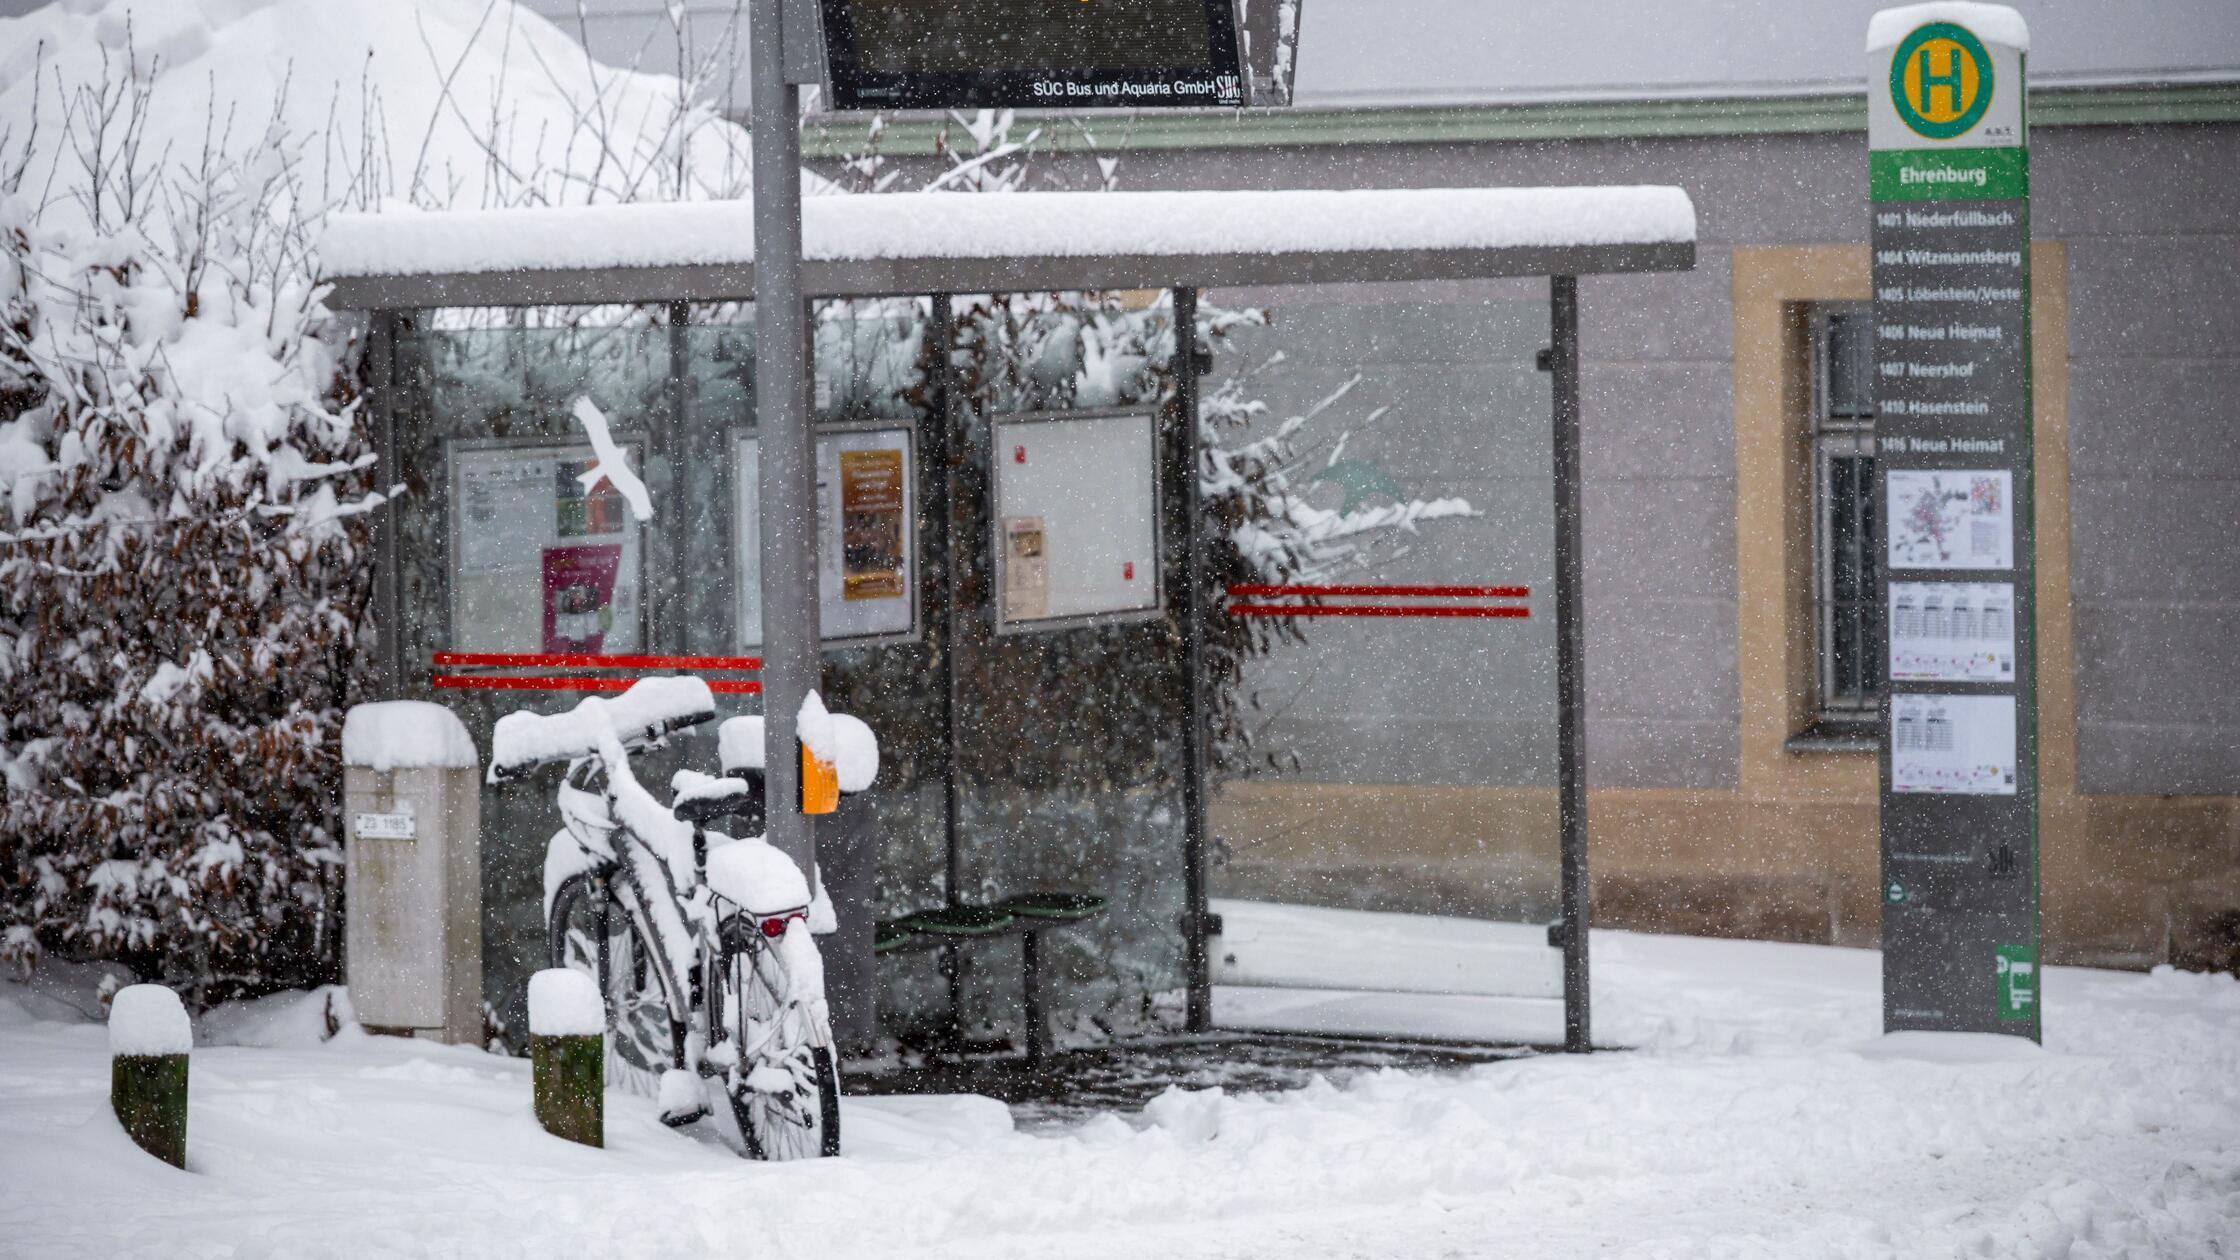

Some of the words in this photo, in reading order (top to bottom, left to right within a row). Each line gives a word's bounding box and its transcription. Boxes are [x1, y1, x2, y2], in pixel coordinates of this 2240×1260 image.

[1033, 80, 1063, 96] SÜC
[1066, 82, 1091, 96] Bus
[1095, 81, 1119, 95] und
[1121, 81, 1171, 97] Aquaria
[1173, 80, 1216, 95] GmbH
[1216, 71, 1241, 98] SÜC
[1919, 48, 1962, 113] H
[1900, 166, 1987, 186] Ehrenburg
[1876, 212, 1902, 228] 1401
[1906, 210, 2013, 227] Niederfüllbach
[1906, 250, 2021, 267] Witzmannsberg
[1907, 325, 1945, 341] Neue
[1949, 324, 2003, 341] Heimat
[1879, 361, 1905, 378] 1407
[1908, 361, 1974, 378] Neershof
[1908, 400, 1989, 416] Hasenstein
[1910, 438, 1948, 453] Neue
[1950, 438, 2004, 453] Heimat
